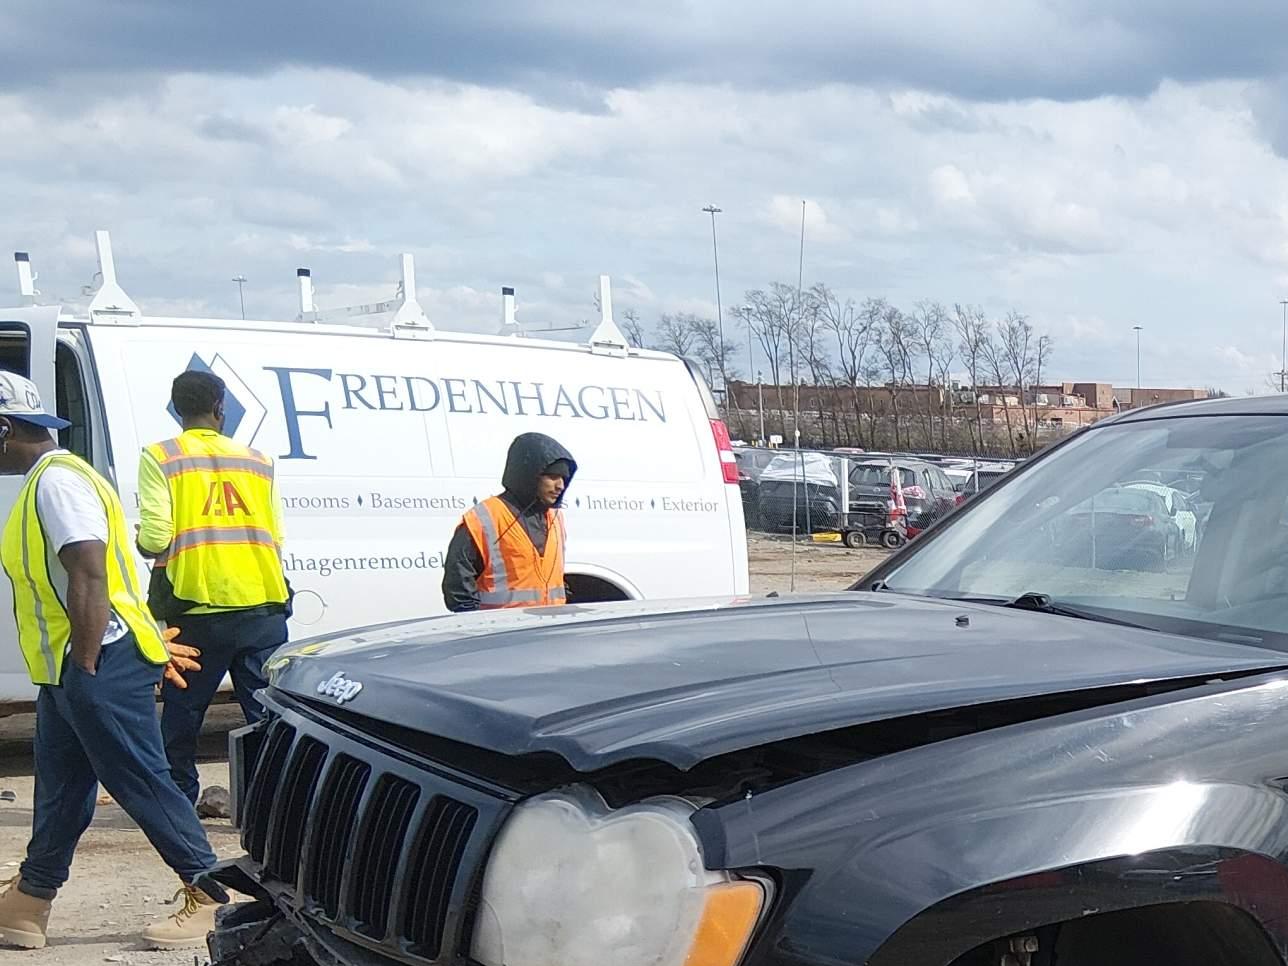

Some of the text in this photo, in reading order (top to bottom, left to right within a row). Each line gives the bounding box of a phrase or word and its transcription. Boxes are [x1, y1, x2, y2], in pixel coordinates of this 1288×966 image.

[263, 366, 667, 460] FREDENHAGEN
[370, 493, 465, 509] Basements
[587, 496, 646, 511] Interior
[662, 497, 718, 513] Exterior
[317, 671, 363, 704] Jeep
